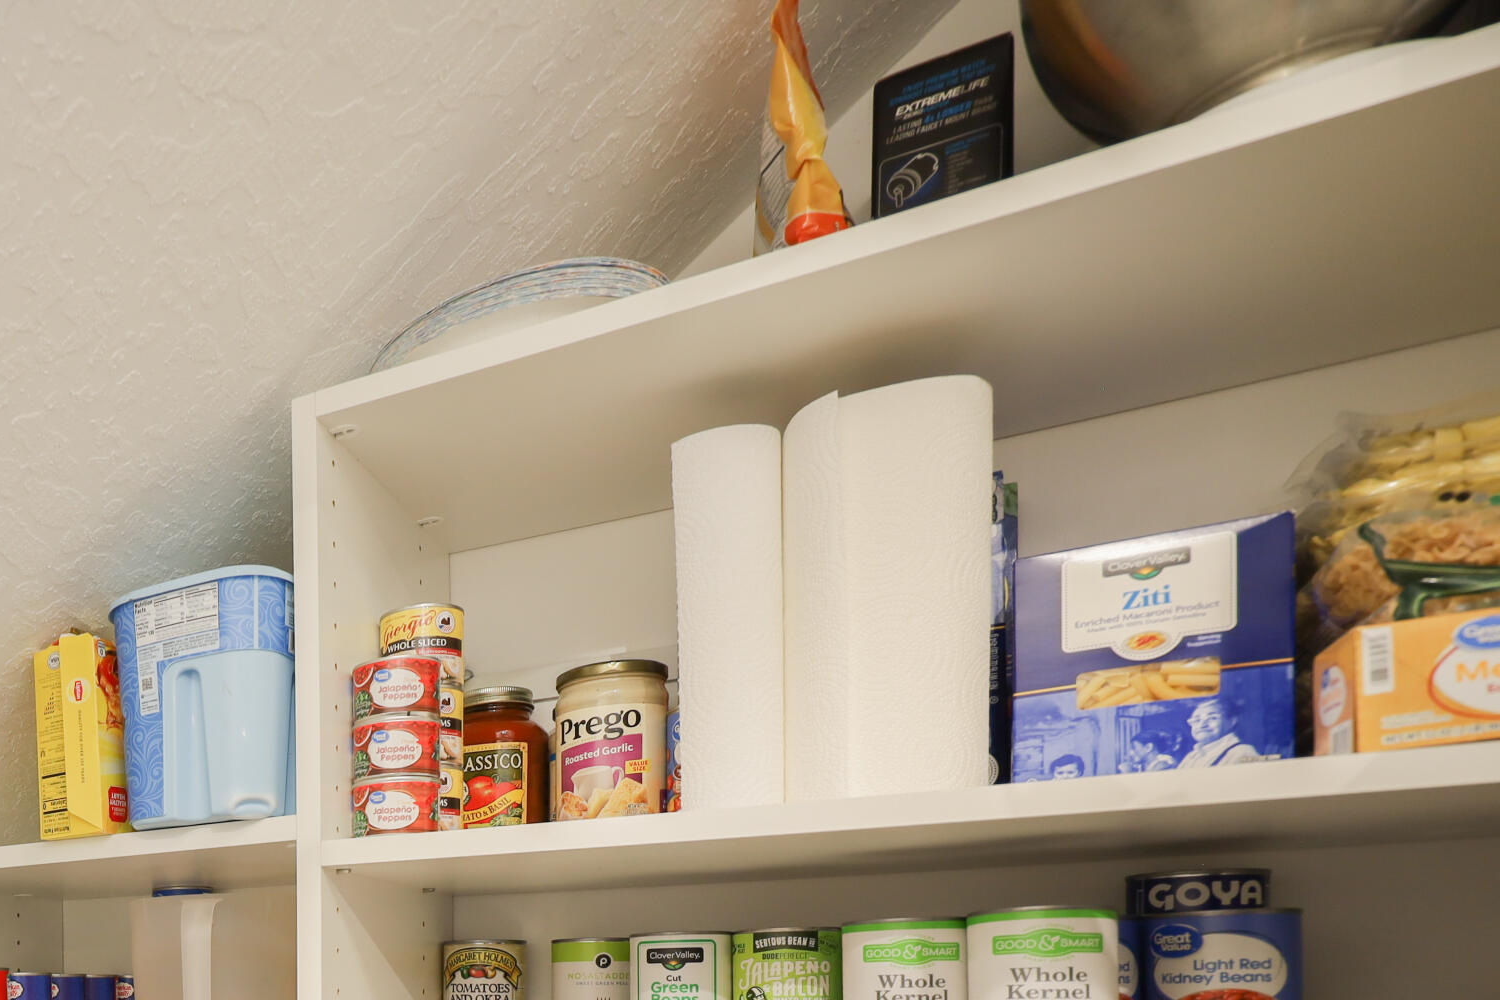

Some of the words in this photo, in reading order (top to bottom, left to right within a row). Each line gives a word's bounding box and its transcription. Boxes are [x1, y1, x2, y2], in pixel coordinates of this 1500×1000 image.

[895, 76, 990, 117] EXTREMELIFE
[1122, 584, 1171, 610] Ziti
[388, 641, 415, 653] WHOLE
[418, 639, 446, 647] SLICED
[560, 710, 641, 745] Prego
[565, 749, 600, 766] Roasted
[602, 743, 633, 755] Garlic
[1148, 880, 1263, 911] GOYA
[755, 937, 787, 949] SERIOUS
[788, 936, 808, 945] BEAN
[1154, 932, 1191, 946] Great
[449, 951, 482, 969] MARGARET
[483, 952, 514, 969] HOLMES
[1193, 958, 1237, 972] Light
[1240, 958, 1273, 970] Red
[878, 973, 946, 990] Whole
[1010, 966, 1088, 984] Whole
[1161, 972, 1215, 986] Kidney
[1219, 972, 1273, 984] Beans
[451, 983, 510, 994] TOMATOES
[651, 982, 699, 993] Green
[1006, 984, 1091, 1000] Kernel
